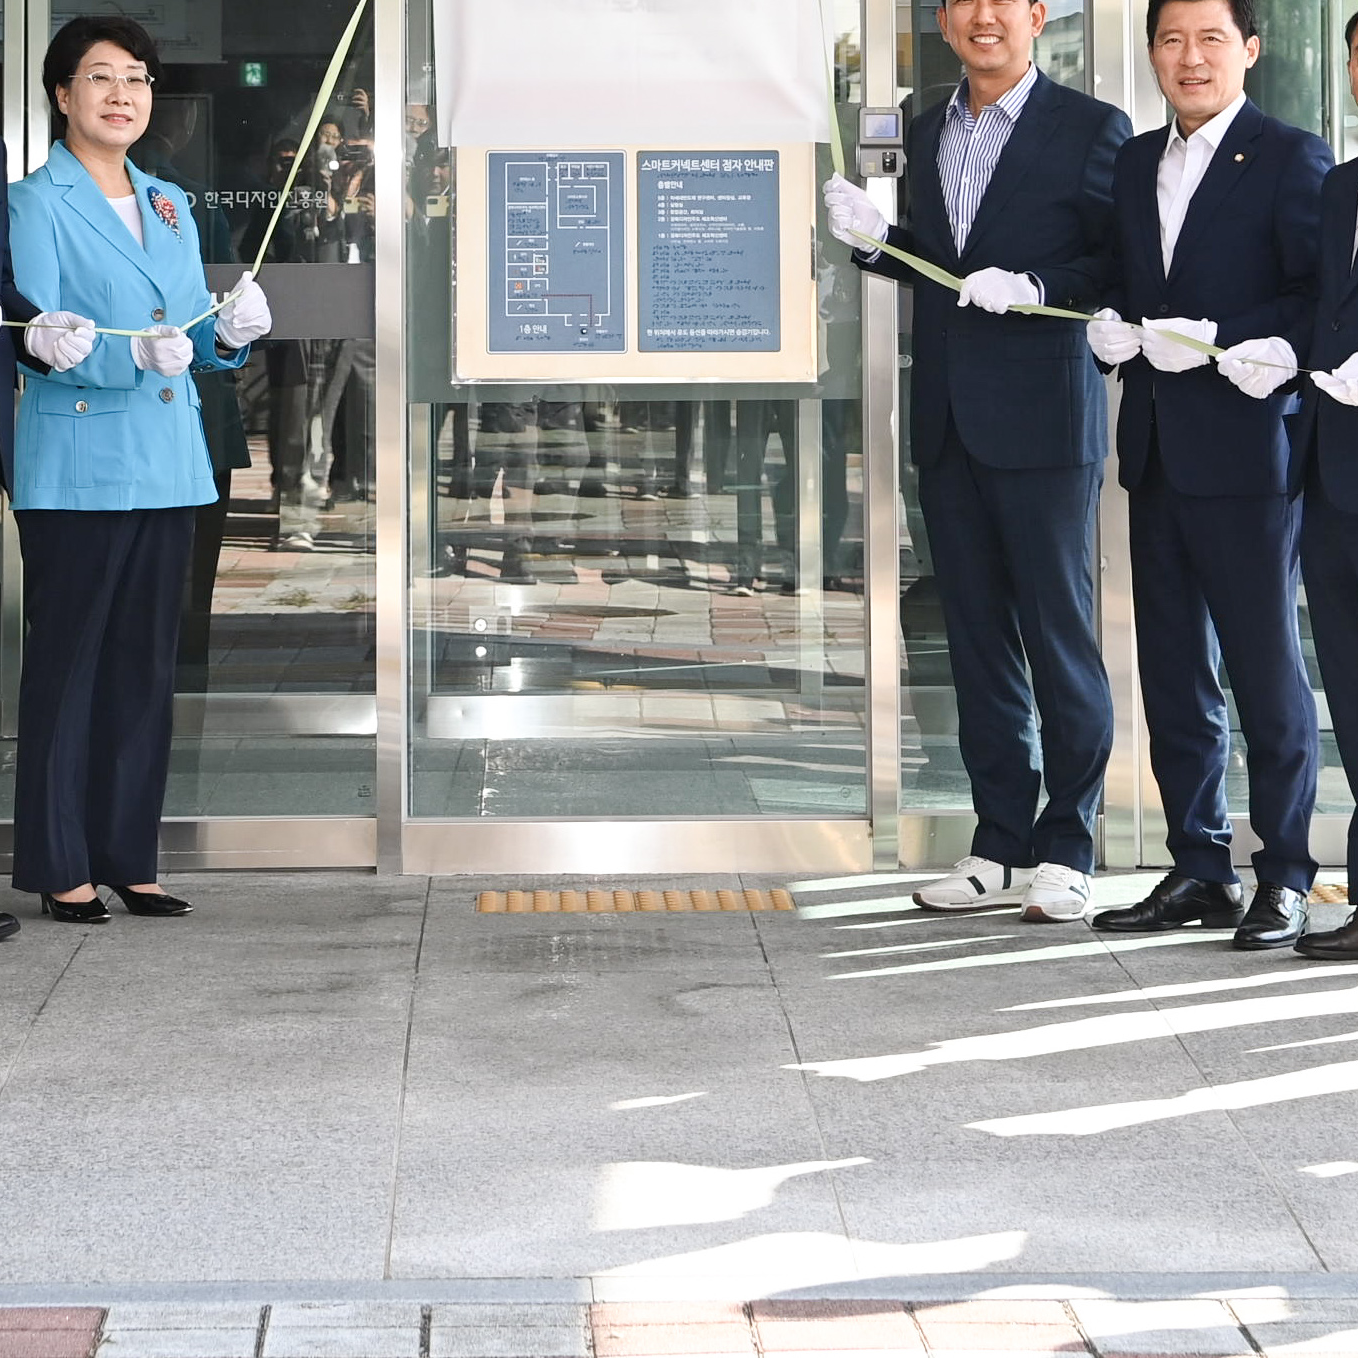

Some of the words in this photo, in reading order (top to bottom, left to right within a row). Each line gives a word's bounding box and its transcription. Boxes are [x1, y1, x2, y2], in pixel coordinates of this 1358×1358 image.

[641, 158, 719, 172] 스마트커넥트센터
[722, 158, 742, 172] 점자
[744, 158, 774, 172] 안내판
[204, 190, 329, 209] 한국디자인진흥원
[532, 324, 548, 335] 안내
